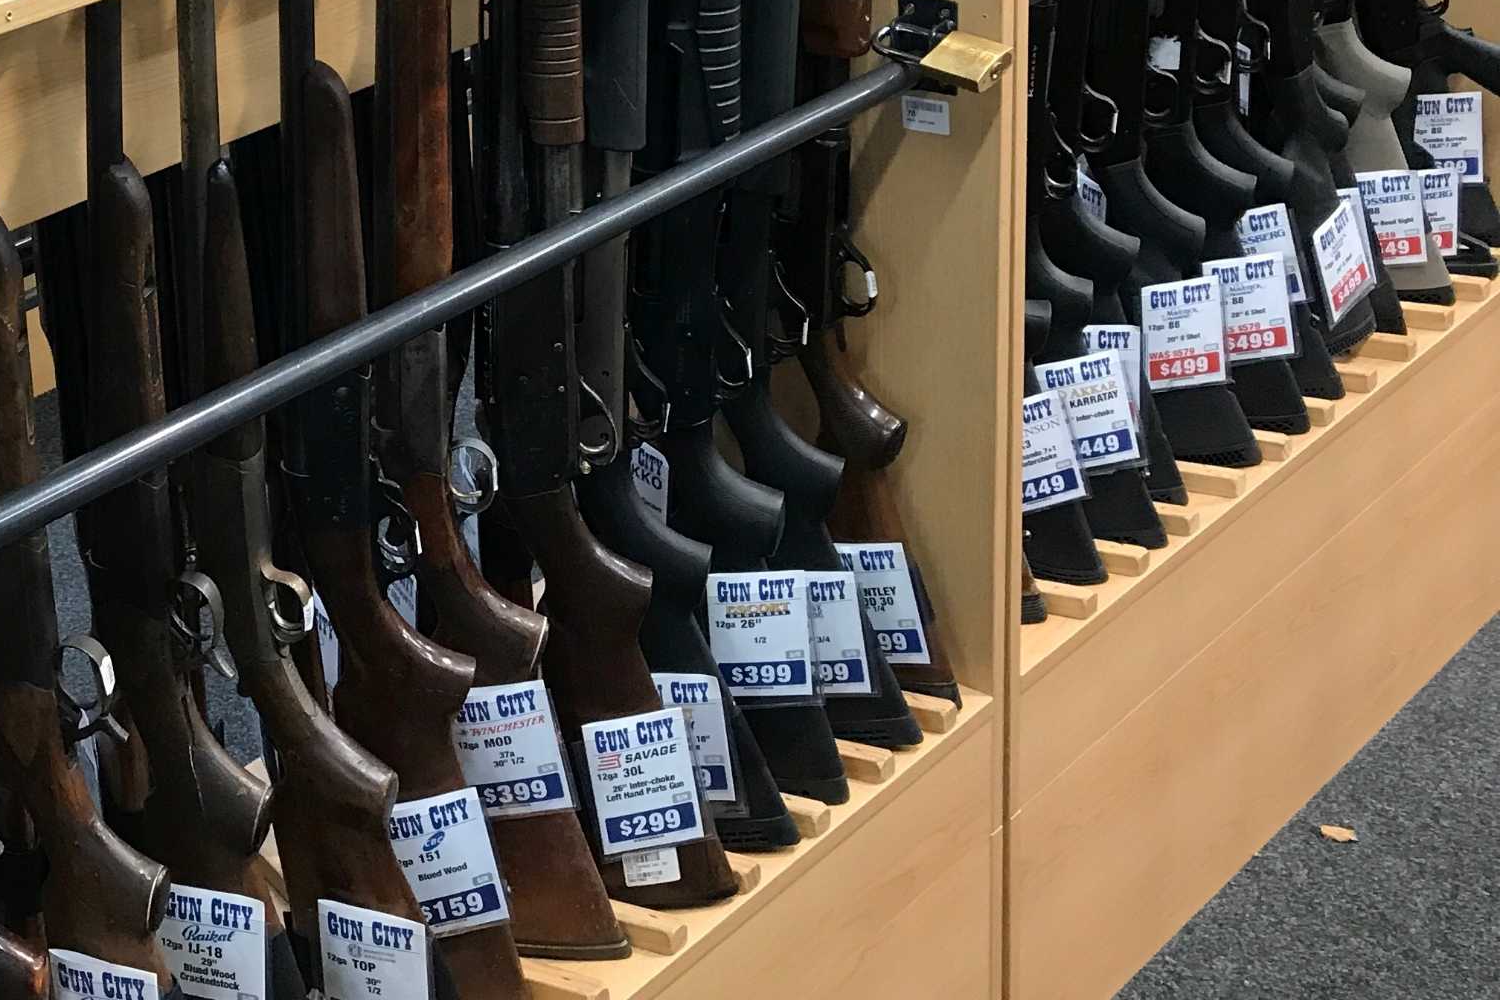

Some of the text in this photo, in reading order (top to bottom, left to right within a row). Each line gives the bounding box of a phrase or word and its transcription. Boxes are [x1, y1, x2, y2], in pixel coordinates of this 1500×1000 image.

[1446, 97, 1474, 113] CITY
[1358, 175, 1411, 195] UN CITY
[1424, 173, 1451, 190] CITY
[1082, 183, 1105, 206] CITY
[1248, 210, 1278, 232] CITY
[1320, 226, 1336, 251] GUN
[1334, 207, 1349, 234] CITY
[1241, 228, 1286, 244] SSBERG
[1245, 259, 1274, 280] CITY
[1150, 283, 1211, 309] GUN CITY
[1098, 330, 1130, 349] CITY
[1228, 331, 1275, 350] $499
[1045, 357, 1112, 389] GUN CITY
[1160, 356, 1209, 376] $499
[1024, 398, 1052, 424] CITY
[1080, 435, 1120, 457] 449
[638, 447, 663, 476] CITY
[631, 463, 662, 490] KKO
[1024, 474, 1065, 498] 449
[859, 549, 895, 570] CITY
[717, 578, 795, 603] GUN CITY
[809, 580, 845, 602] CITY
[863, 586, 896, 597] NTLEY
[715, 619, 761, 629] 12ga 26"
[877, 632, 908, 651] 99
[731, 663, 792, 683] $399
[818, 662, 849, 682] 99
[670, 681, 709, 704] CITY
[495, 689, 536, 718] CITY
[469, 714, 545, 737] WINCHESTER
[595, 717, 674, 753] GUN CITY
[484, 735, 512, 749] MOD
[625, 743, 677, 764] SAVAGE
[597, 765, 645, 782] 12ga 30L
[629, 774, 676, 791] Inter-choke
[483, 780, 548, 804] $399
[606, 791, 622, 803] Left
[624, 787, 644, 799] Hand
[646, 783, 667, 796] Parts
[389, 798, 469, 840] GUN CITY
[620, 808, 681, 837] $299
[419, 850, 441, 864] 151
[444, 862, 467, 875] Wood
[166, 891, 253, 930] GUN CITY
[420, 891, 484, 923] $159
[182, 924, 235, 943] Baikal
[327, 911, 414, 950] GUN CITY
[161, 937, 223, 959] 12ga IJ-18
[211, 968, 236, 980] Wood
[352, 958, 376, 972] TOP
[58, 962, 145, 1000] GUN CITY
[367, 986, 381, 996] 1/2
